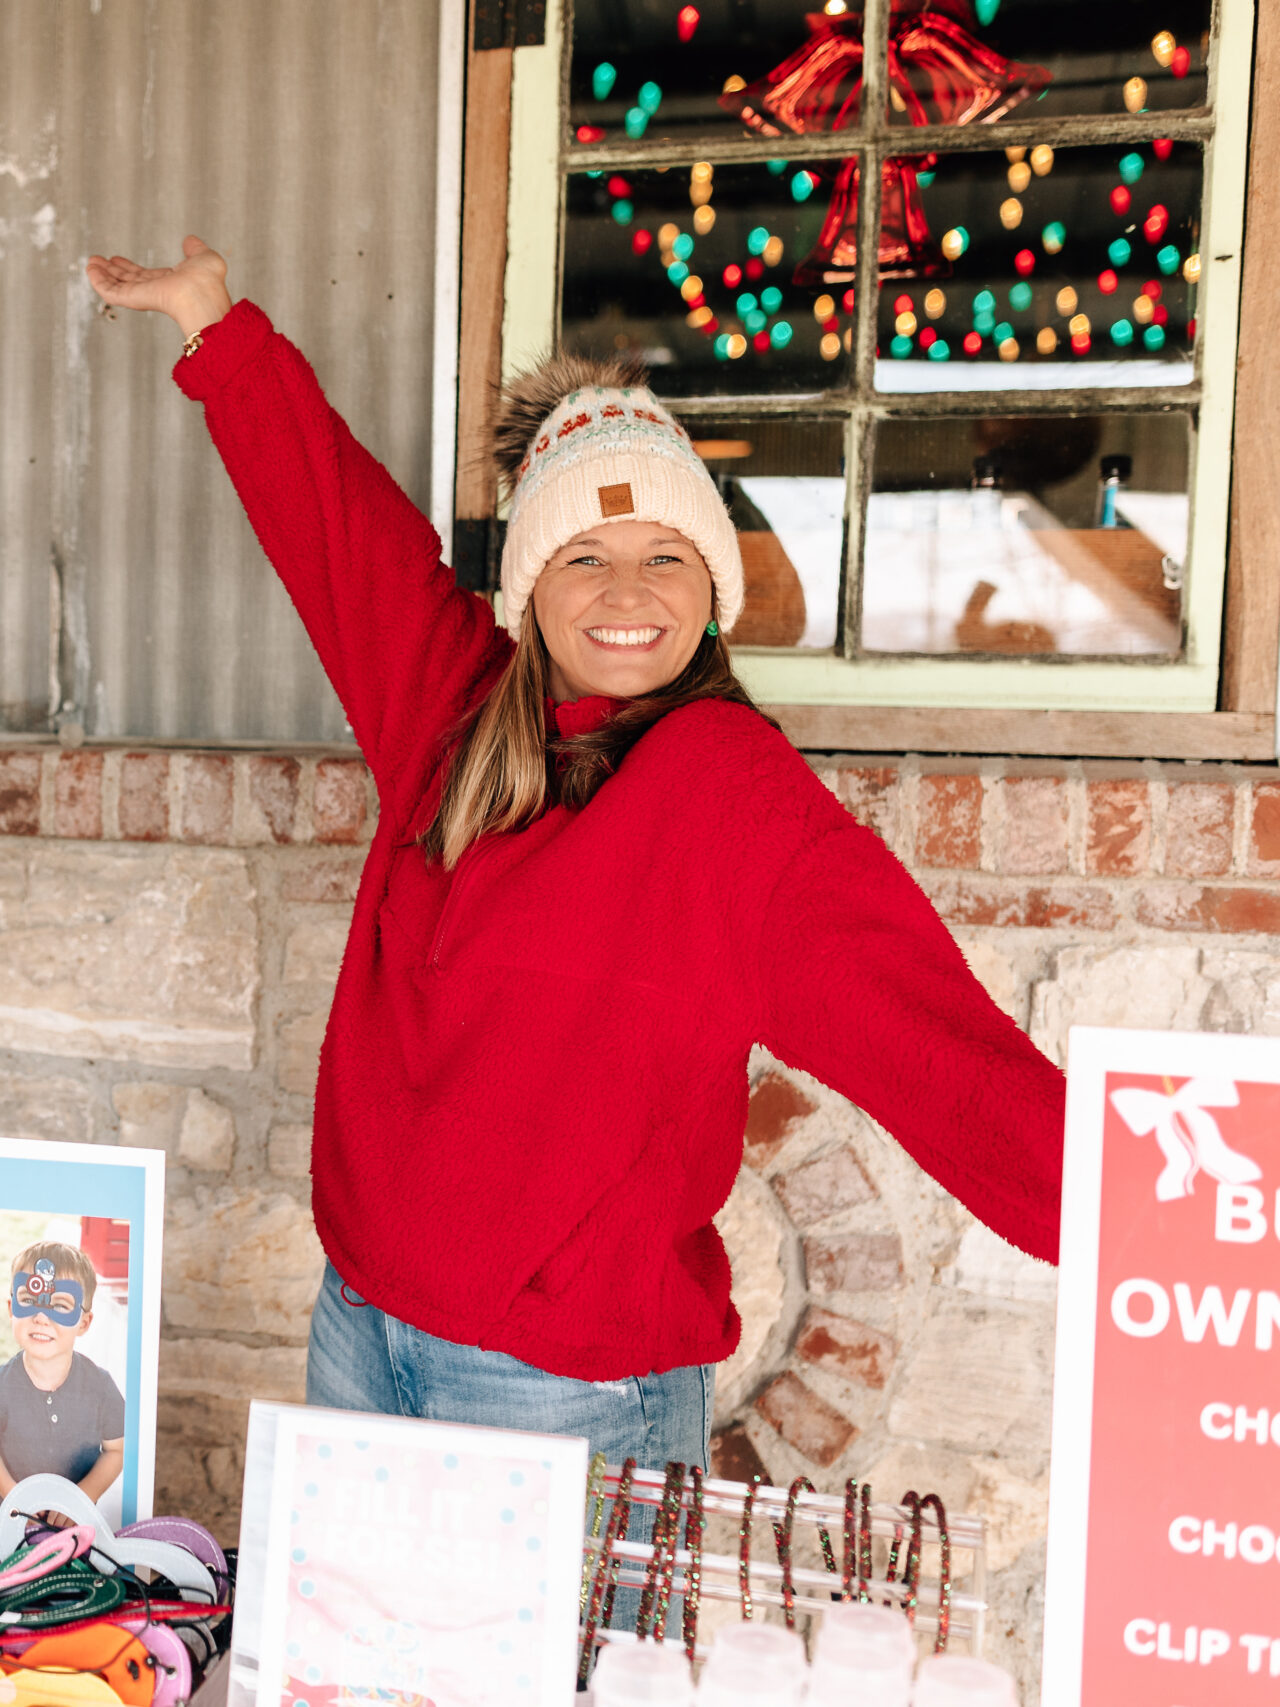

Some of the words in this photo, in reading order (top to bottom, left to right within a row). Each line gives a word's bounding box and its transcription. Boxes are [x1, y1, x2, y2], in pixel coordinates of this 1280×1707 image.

[1215, 1183, 1280, 1244] B
[1200, 1402, 1280, 1446] CH
[1168, 1515, 1280, 1564] CHO
[1123, 1618, 1231, 1666] CLIP
